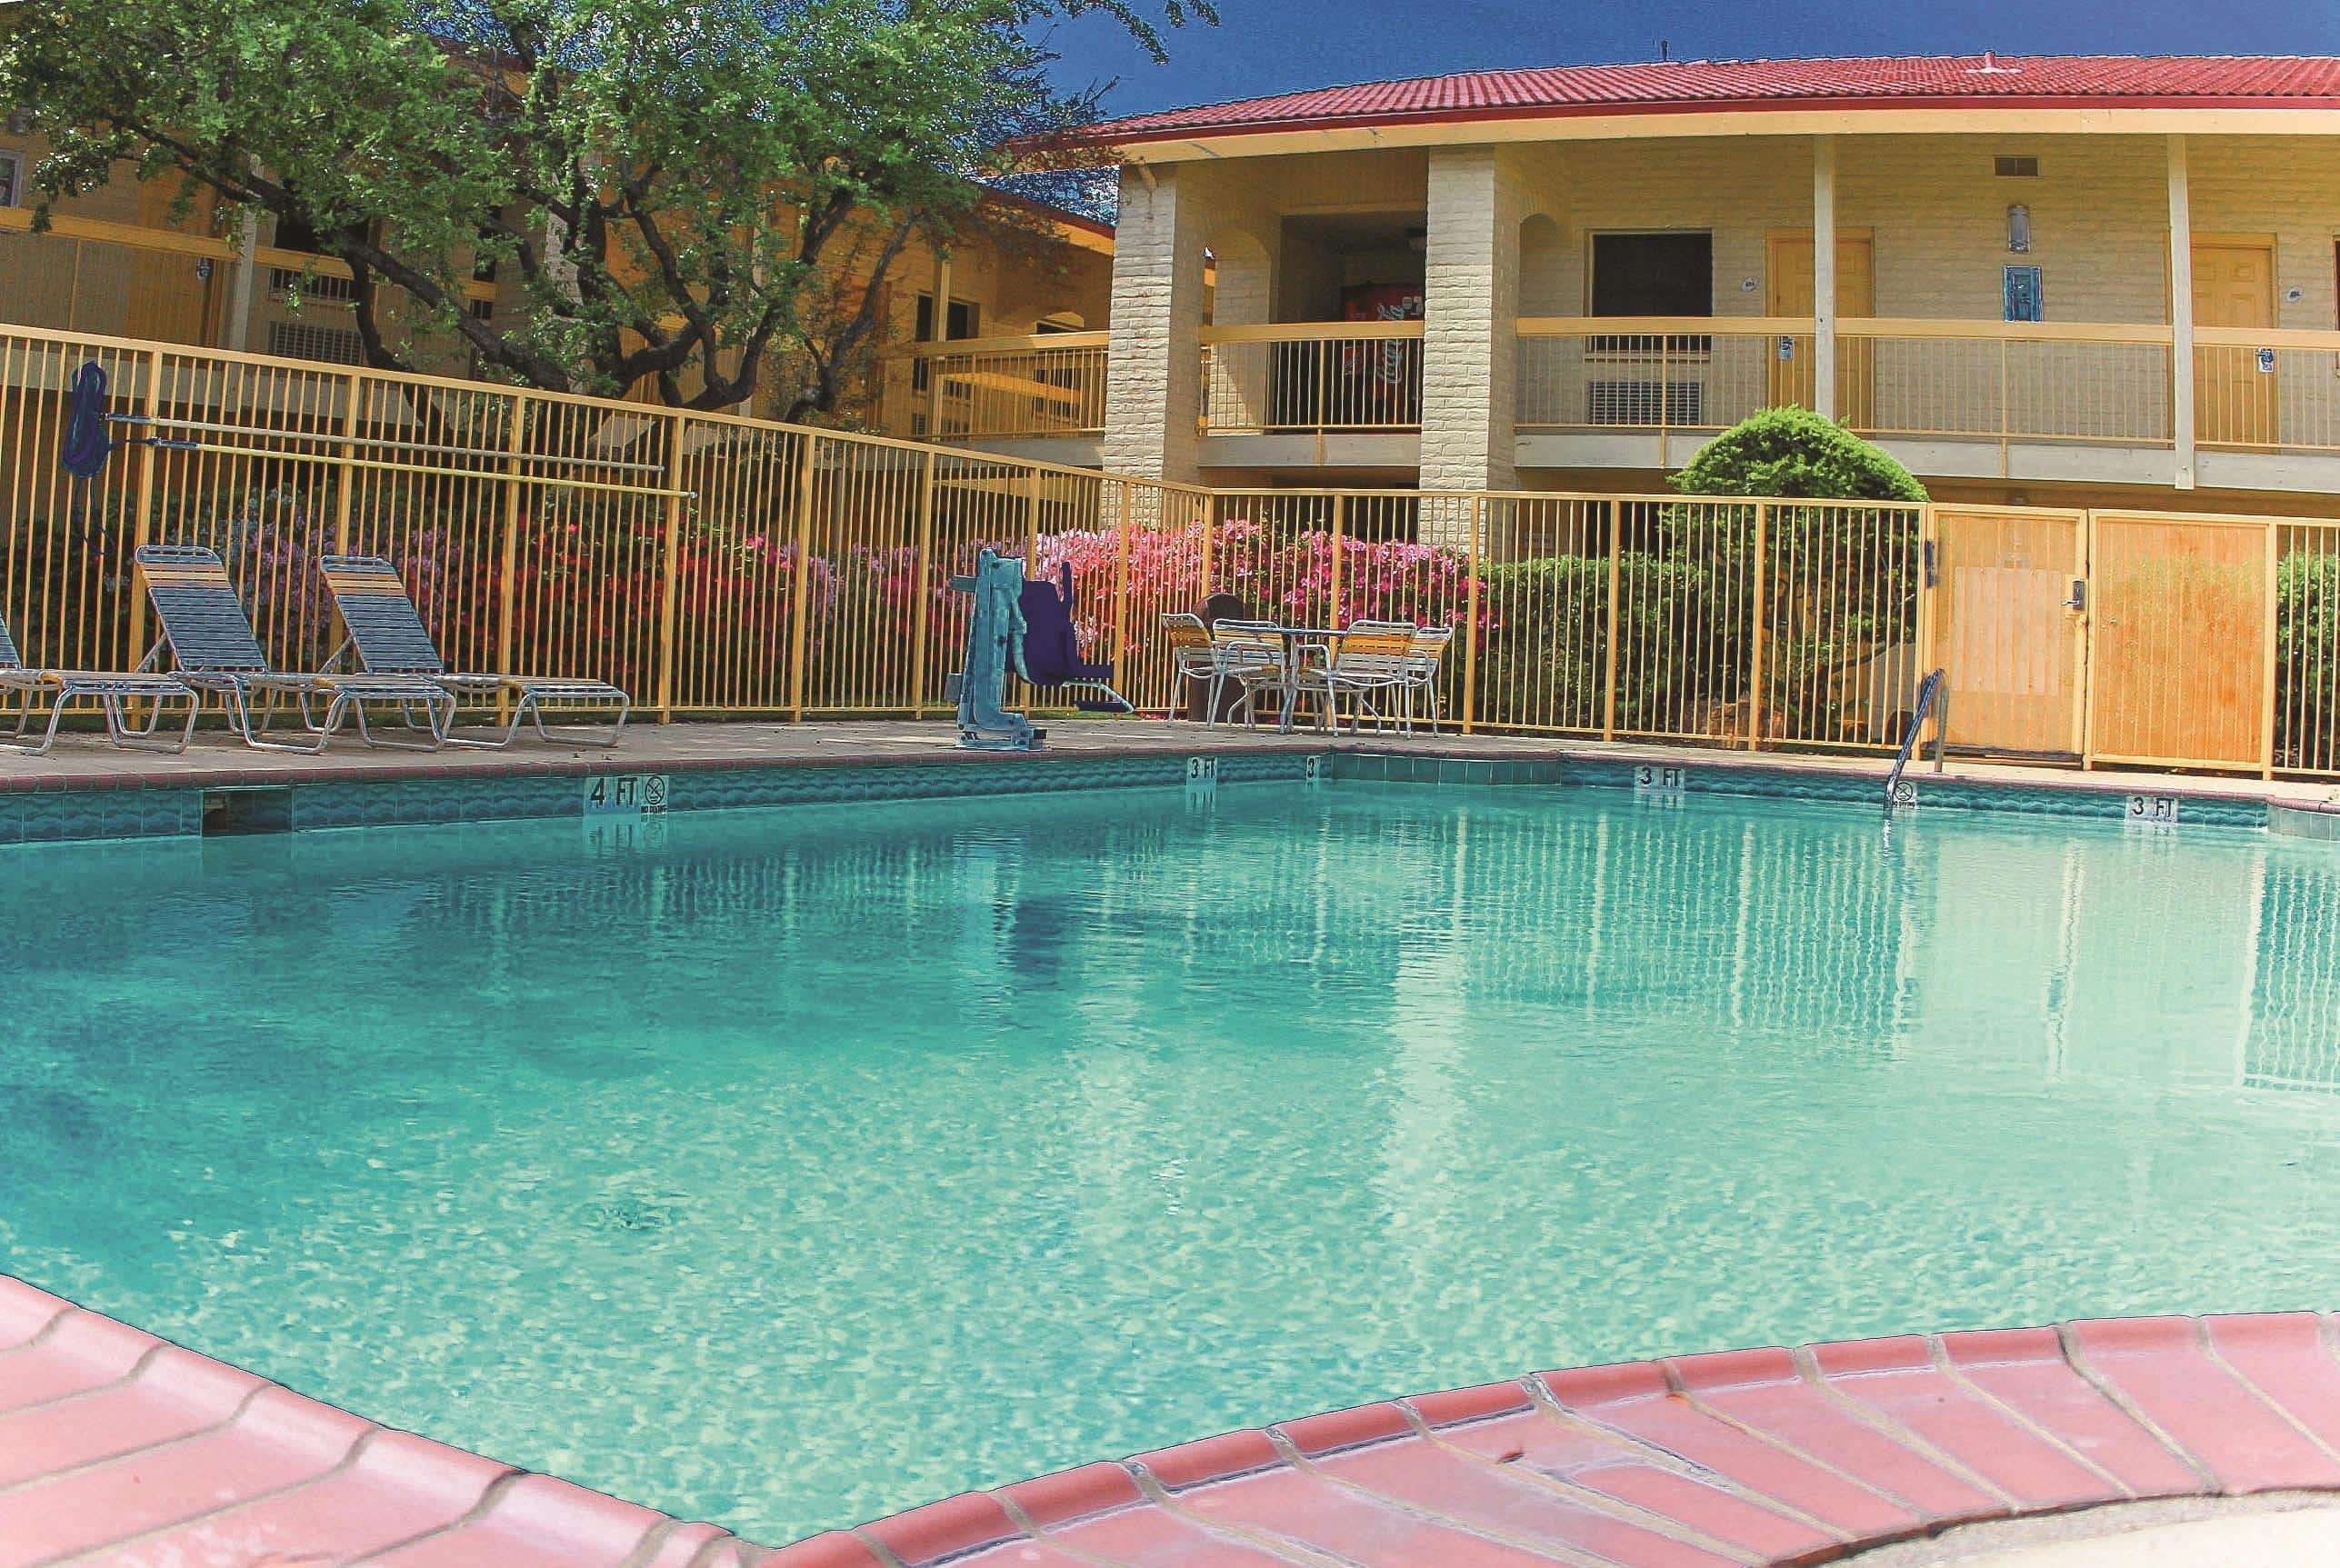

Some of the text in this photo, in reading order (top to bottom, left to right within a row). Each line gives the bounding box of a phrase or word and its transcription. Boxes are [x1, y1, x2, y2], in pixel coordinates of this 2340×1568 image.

[1191, 758, 1199, 778] 3
[1639, 766, 1682, 787] 3 FT
[590, 776, 638, 806] 4 FT
[2132, 796, 2175, 818] 3 FT
